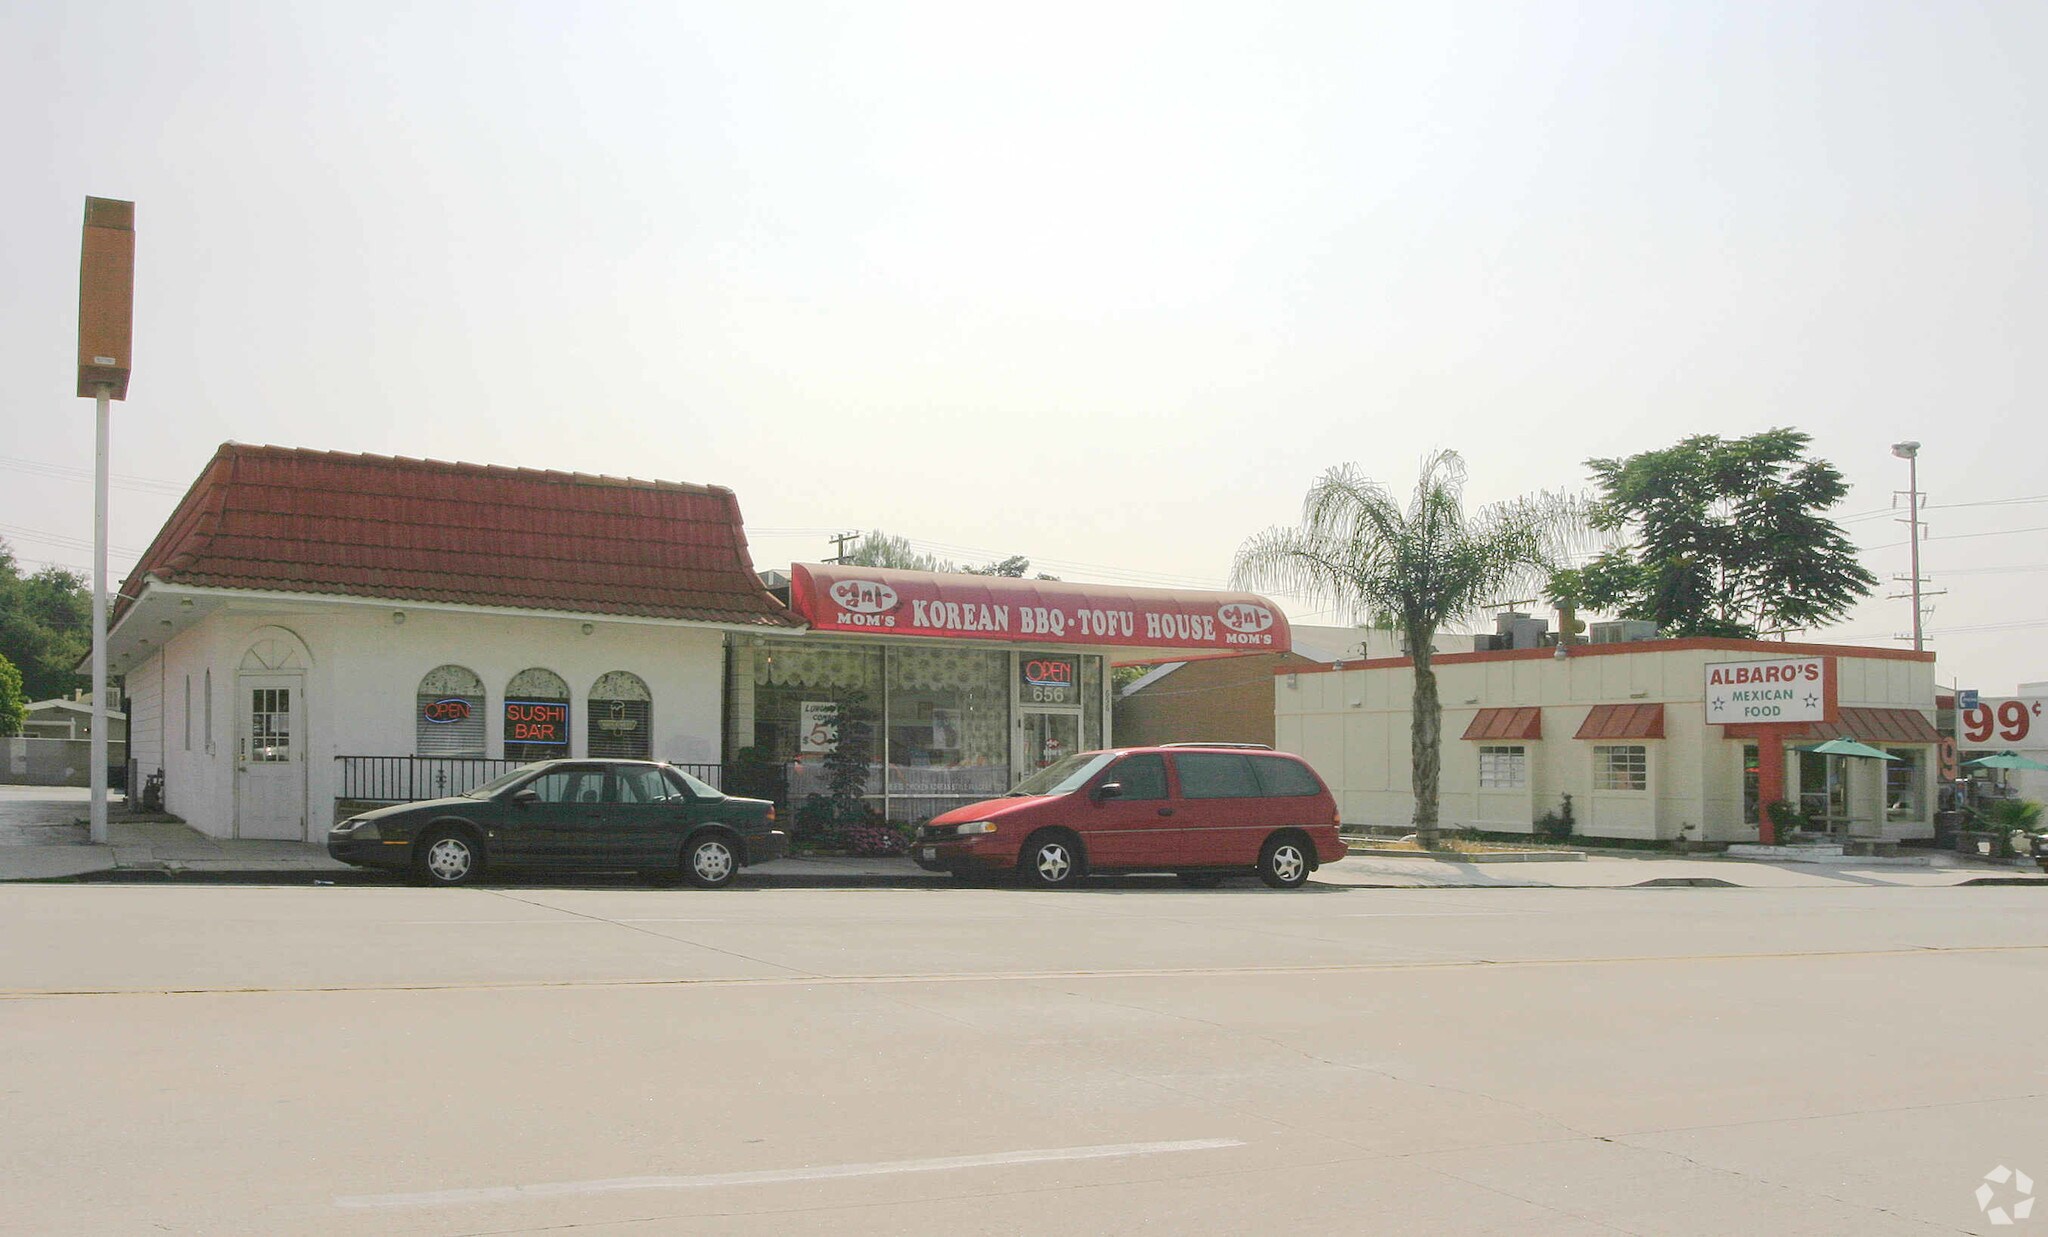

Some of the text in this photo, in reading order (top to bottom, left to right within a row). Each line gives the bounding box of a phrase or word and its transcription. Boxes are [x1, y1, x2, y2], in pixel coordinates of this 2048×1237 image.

[837, 612, 896, 627] MOM'S
[912, 599, 1009, 632] KOREAN
[1146, 613, 1216, 642] HOUSE
[1225, 633, 1272, 646] MOM'S
[1025, 660, 1071, 682] OPEN
[1710, 663, 1819, 686] ALBARO'S
[1033, 687, 1064, 702] 656
[1732, 689, 1793, 702] MEXICAN
[424, 702, 471, 719] OPEN
[507, 704, 565, 722] SUSHI
[1744, 705, 1781, 717] FOOD
[515, 724, 555, 740] BAR
